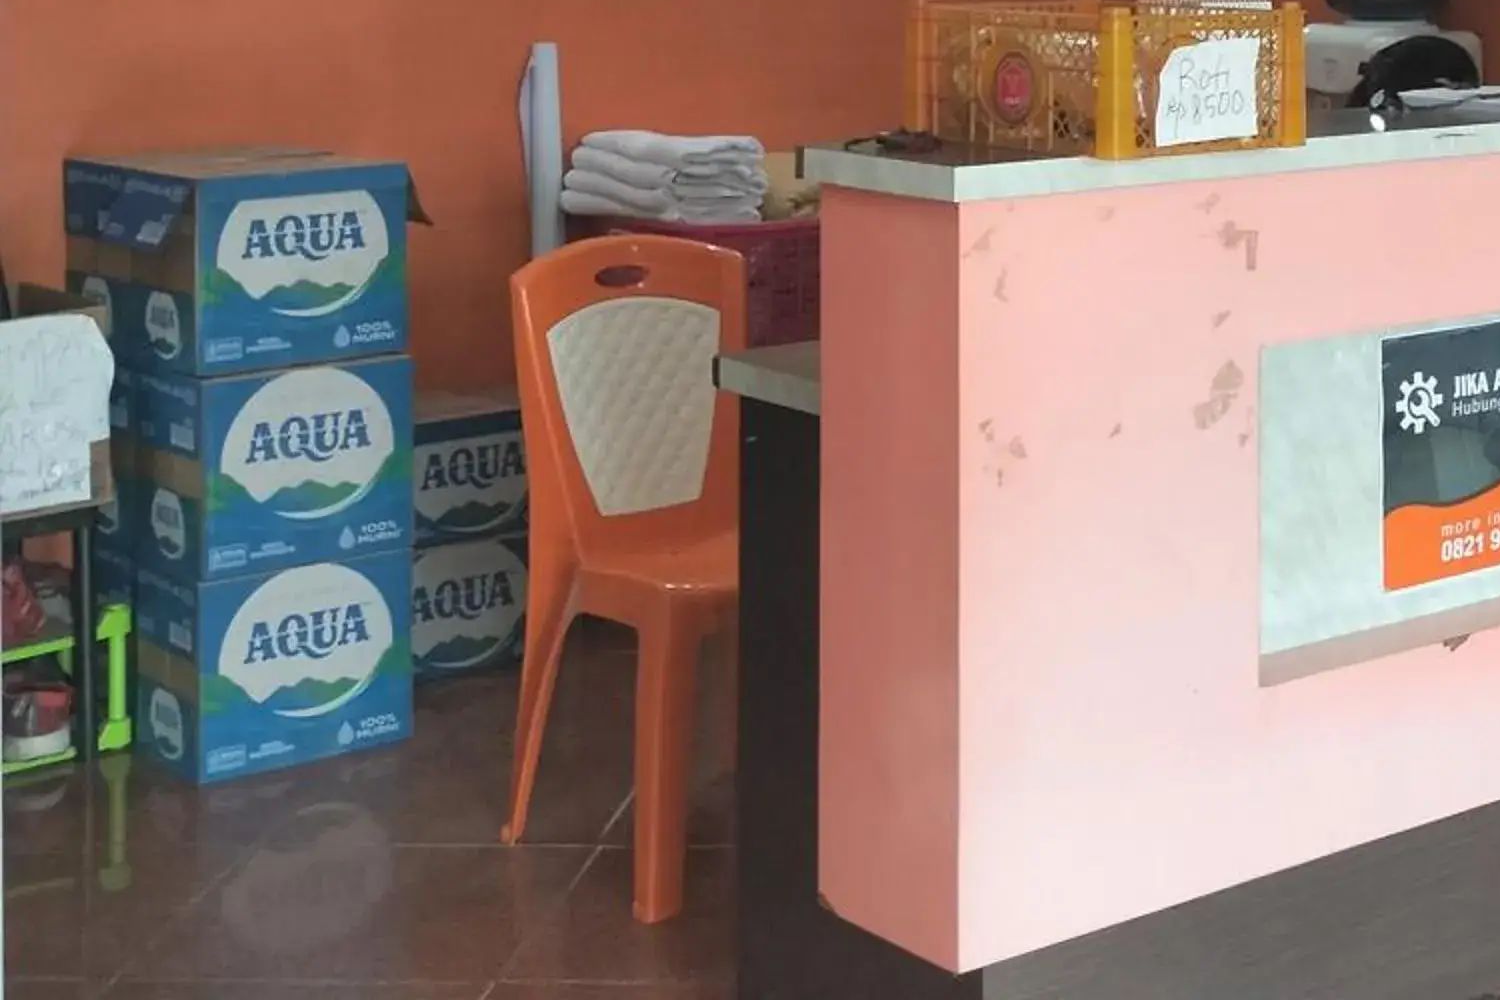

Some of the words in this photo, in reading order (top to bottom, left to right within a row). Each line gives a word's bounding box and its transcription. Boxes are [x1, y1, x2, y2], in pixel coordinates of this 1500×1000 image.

[241, 210, 366, 260] AQUA
[1453, 371, 1489, 399] JIKA
[245, 408, 372, 464] AQUA
[420, 441, 526, 490] AQUA
[1440, 532, 1484, 562] 0821
[1441, 517, 1481, 537] more
[412, 568, 515, 622] AQUA
[243, 603, 370, 665] AQUA
